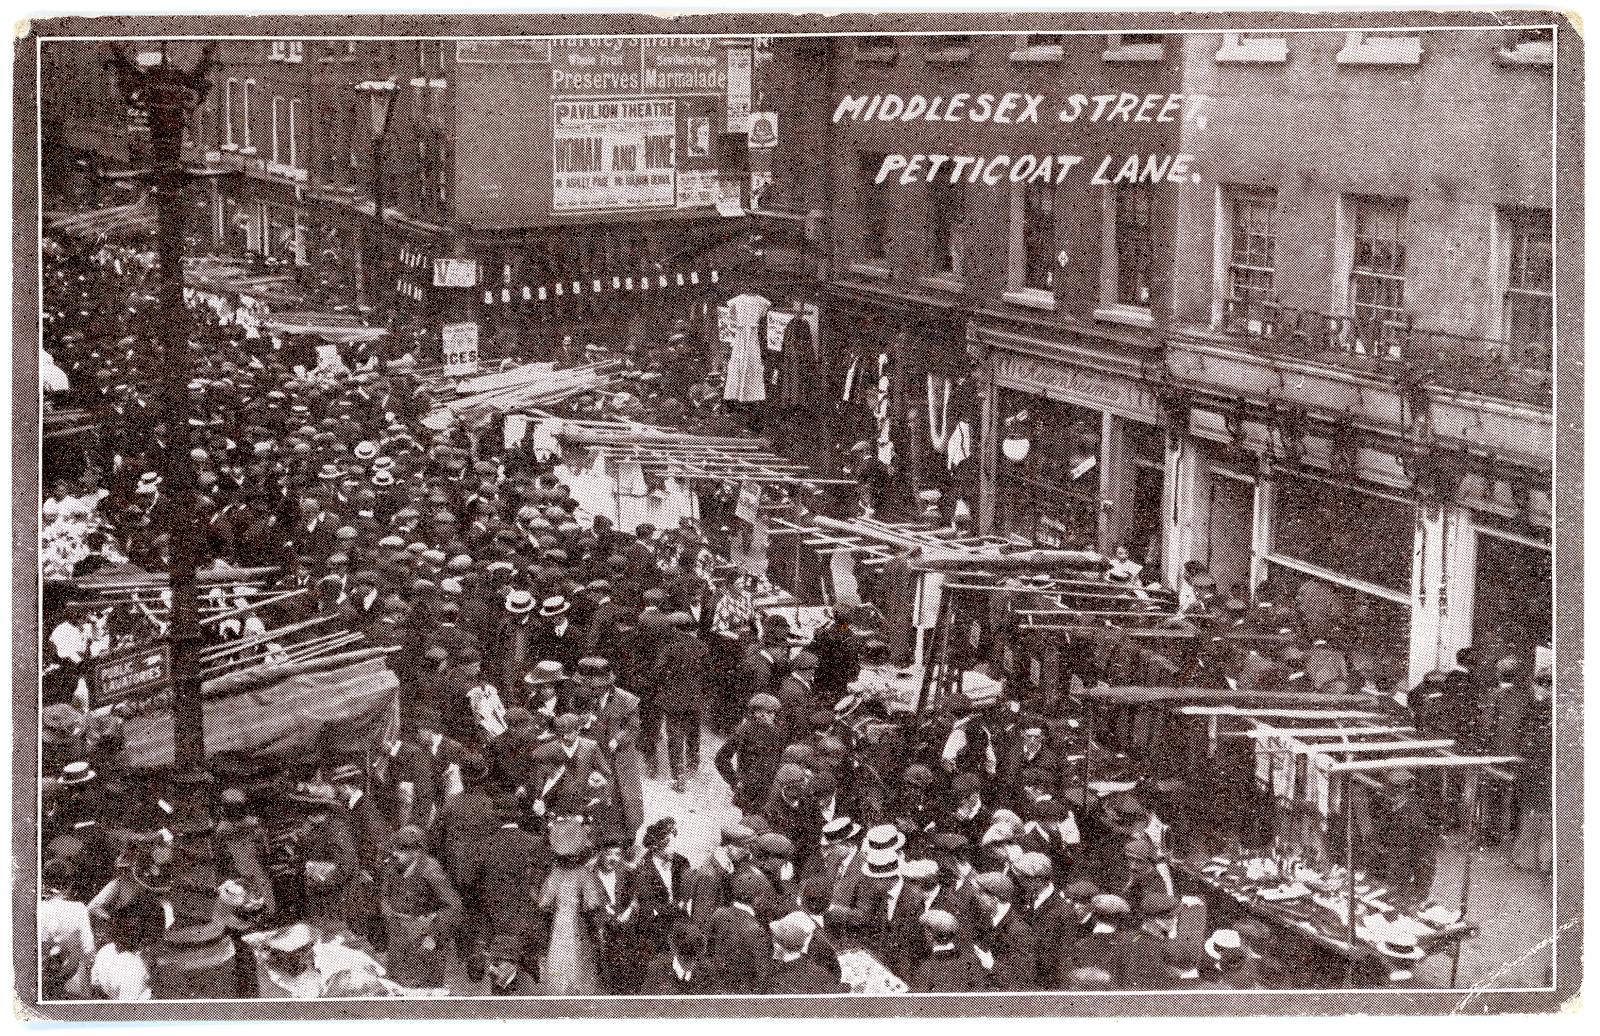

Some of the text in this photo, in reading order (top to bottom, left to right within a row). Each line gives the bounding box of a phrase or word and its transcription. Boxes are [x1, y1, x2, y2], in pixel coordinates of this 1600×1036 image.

[551, 69, 639, 89] Preserves
[645, 68, 727, 88] Marmalade
[555, 101, 674, 125] PAVILION THEATRE
[555, 134, 674, 173] WOMAN AND WINE
[443, 350, 477, 366] ICES
[101, 661, 133, 680] PUBLIC
[103, 666, 162, 694] LAVATORIES
